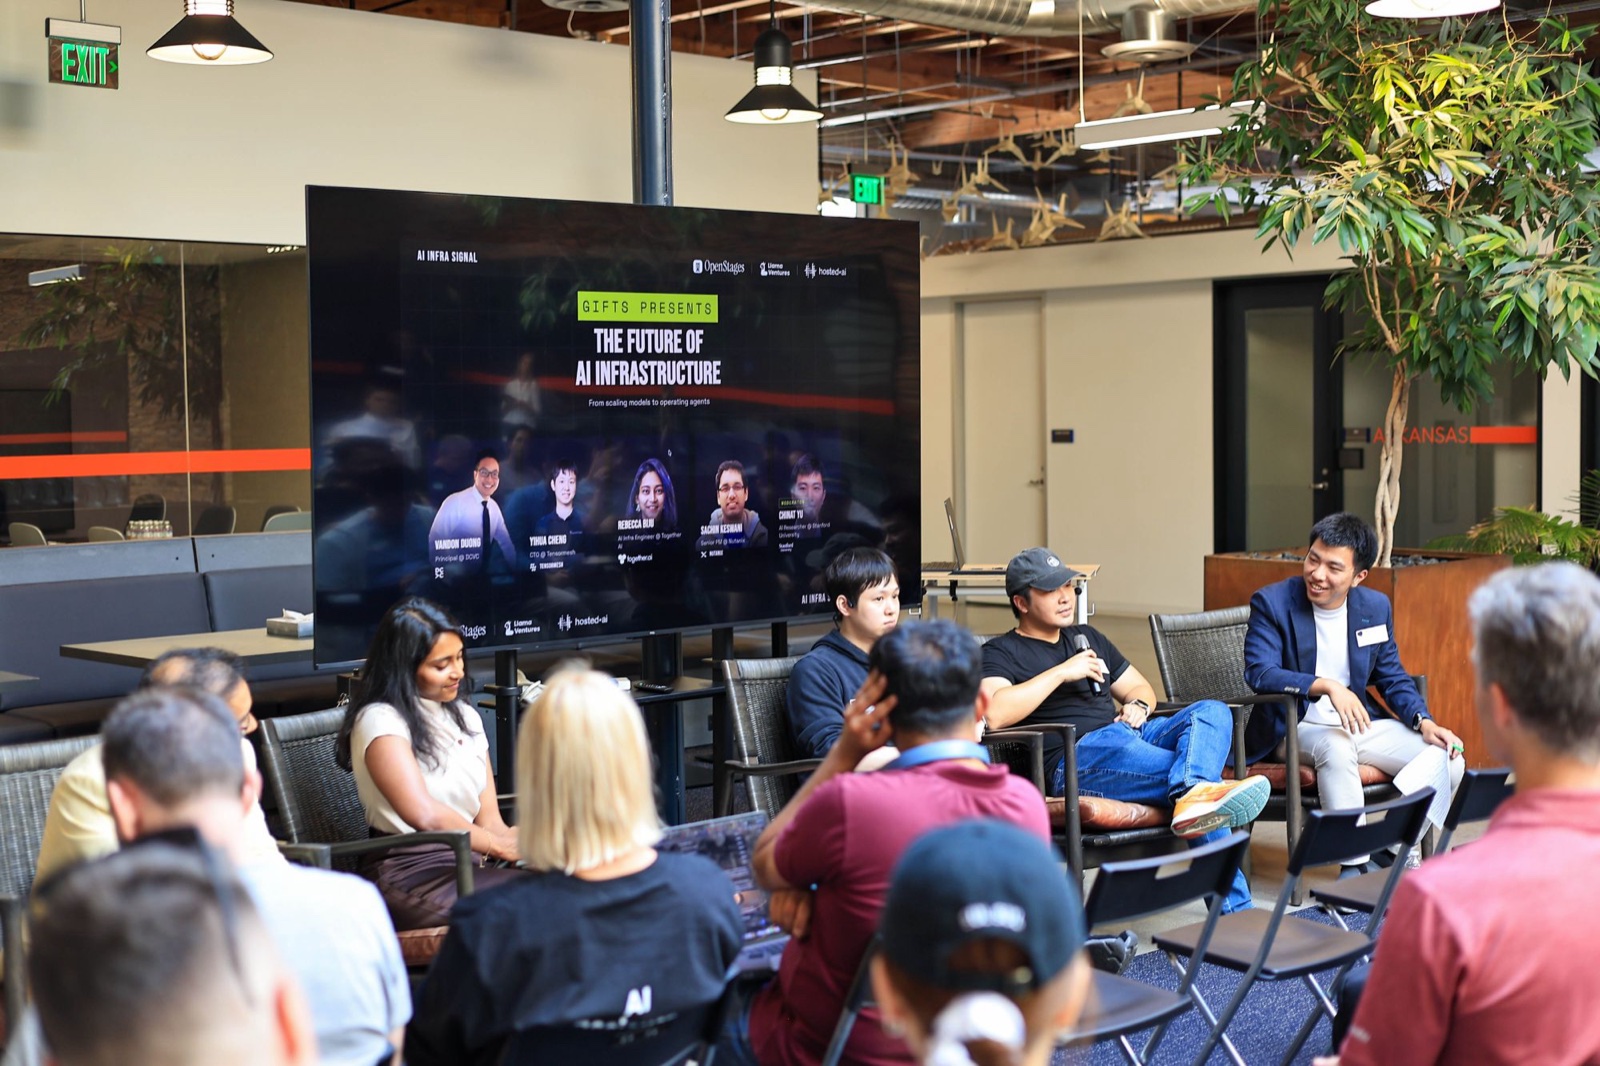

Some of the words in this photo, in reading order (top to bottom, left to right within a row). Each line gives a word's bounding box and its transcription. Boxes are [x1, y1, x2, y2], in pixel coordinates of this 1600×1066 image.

[62, 43, 109, 85] EXIT
[854, 176, 880, 204] EXIT
[417, 249, 425, 261] AI
[427, 250, 449, 262] INFRA
[451, 251, 478, 263] SIGNAL
[704, 259, 745, 276] OpenStages
[768, 269, 791, 277] Ventures
[582, 300, 629, 313] GIFTS
[640, 302, 712, 315] PRESENTS
[593, 328, 624, 354] THE
[627, 328, 683, 354] FUTURE
[685, 329, 704, 354] OF
[575, 360, 591, 386] AI
[595, 360, 722, 386] INFRASTRUCTURE
[588, 399, 605, 407] From
[605, 399, 628, 408] scaling
[628, 399, 651, 407] models
[659, 398, 689, 407] operating
[689, 398, 711, 407] agents
[1372, 426, 1468, 444] AKANSAS
[796, 509, 804, 519] YU
[617, 519, 642, 530] REBECCA
[700, 524, 720, 536] SACHIN
[720, 522, 743, 534] KESWANI
[529, 535, 547, 547] YIHUA
[547, 534, 567, 545] CHENG
[634, 533, 655, 542] Engineer
[655, 532, 661, 541] @
[661, 531, 682, 540] Together
[434, 539, 460, 550] VANDON
[460, 537, 482, 548] DUONG
[434, 554, 459, 562] Principal
[458, 554, 465, 562] @
[465, 553, 480, 561] DCVC
[529, 551, 540, 559] CTO
[540, 551, 546, 559] @
[546, 549, 576, 557] Tensormesh
[801, 594, 808, 605] AI
[809, 592, 826, 604] INFRA
[460, 624, 486, 640] Stages
[514, 626, 541, 635] Ventures
[623, 984, 652, 1019] AI
